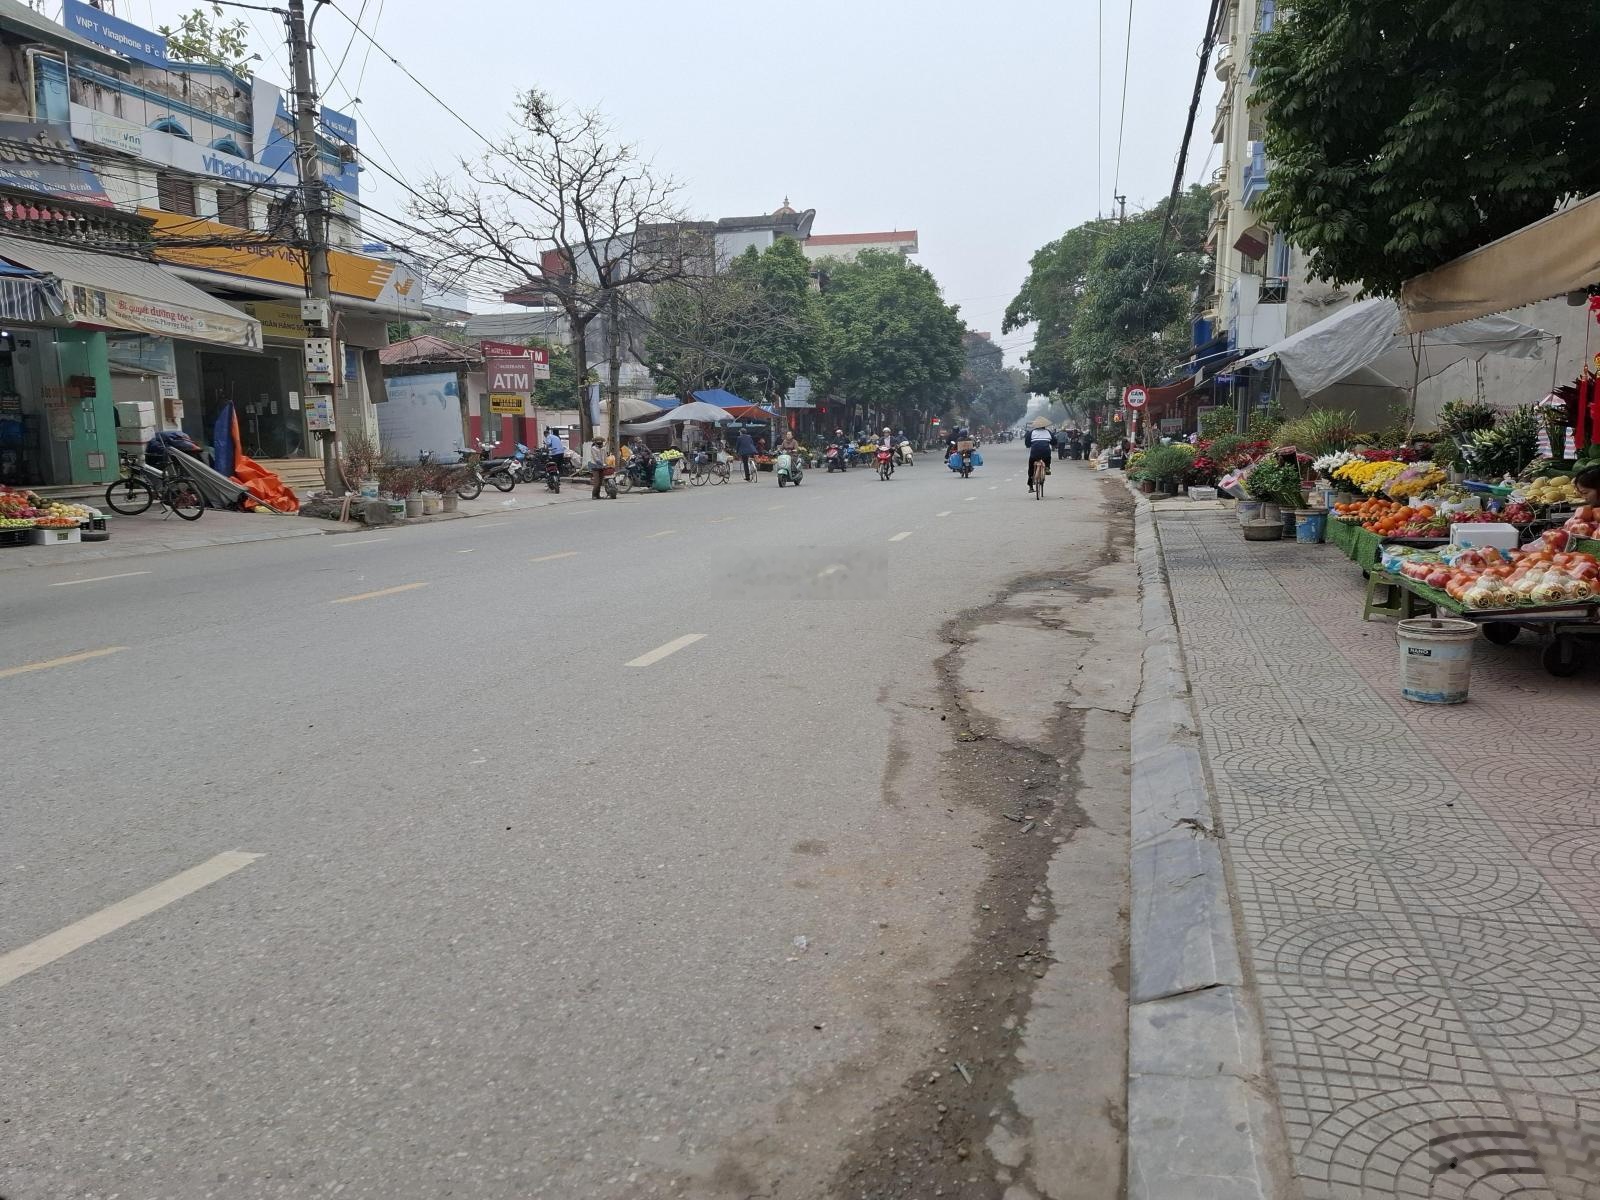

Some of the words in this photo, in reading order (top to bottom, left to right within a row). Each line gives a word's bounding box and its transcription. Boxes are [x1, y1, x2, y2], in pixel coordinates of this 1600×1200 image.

[75, 15, 98, 33] VNPT
[102, 26, 142, 50] Vinaphone
[128, 304, 149, 316] quyết
[176, 312, 190, 323] tóc
[522, 349, 543, 362] ATM
[493, 373, 529, 390] ATM
